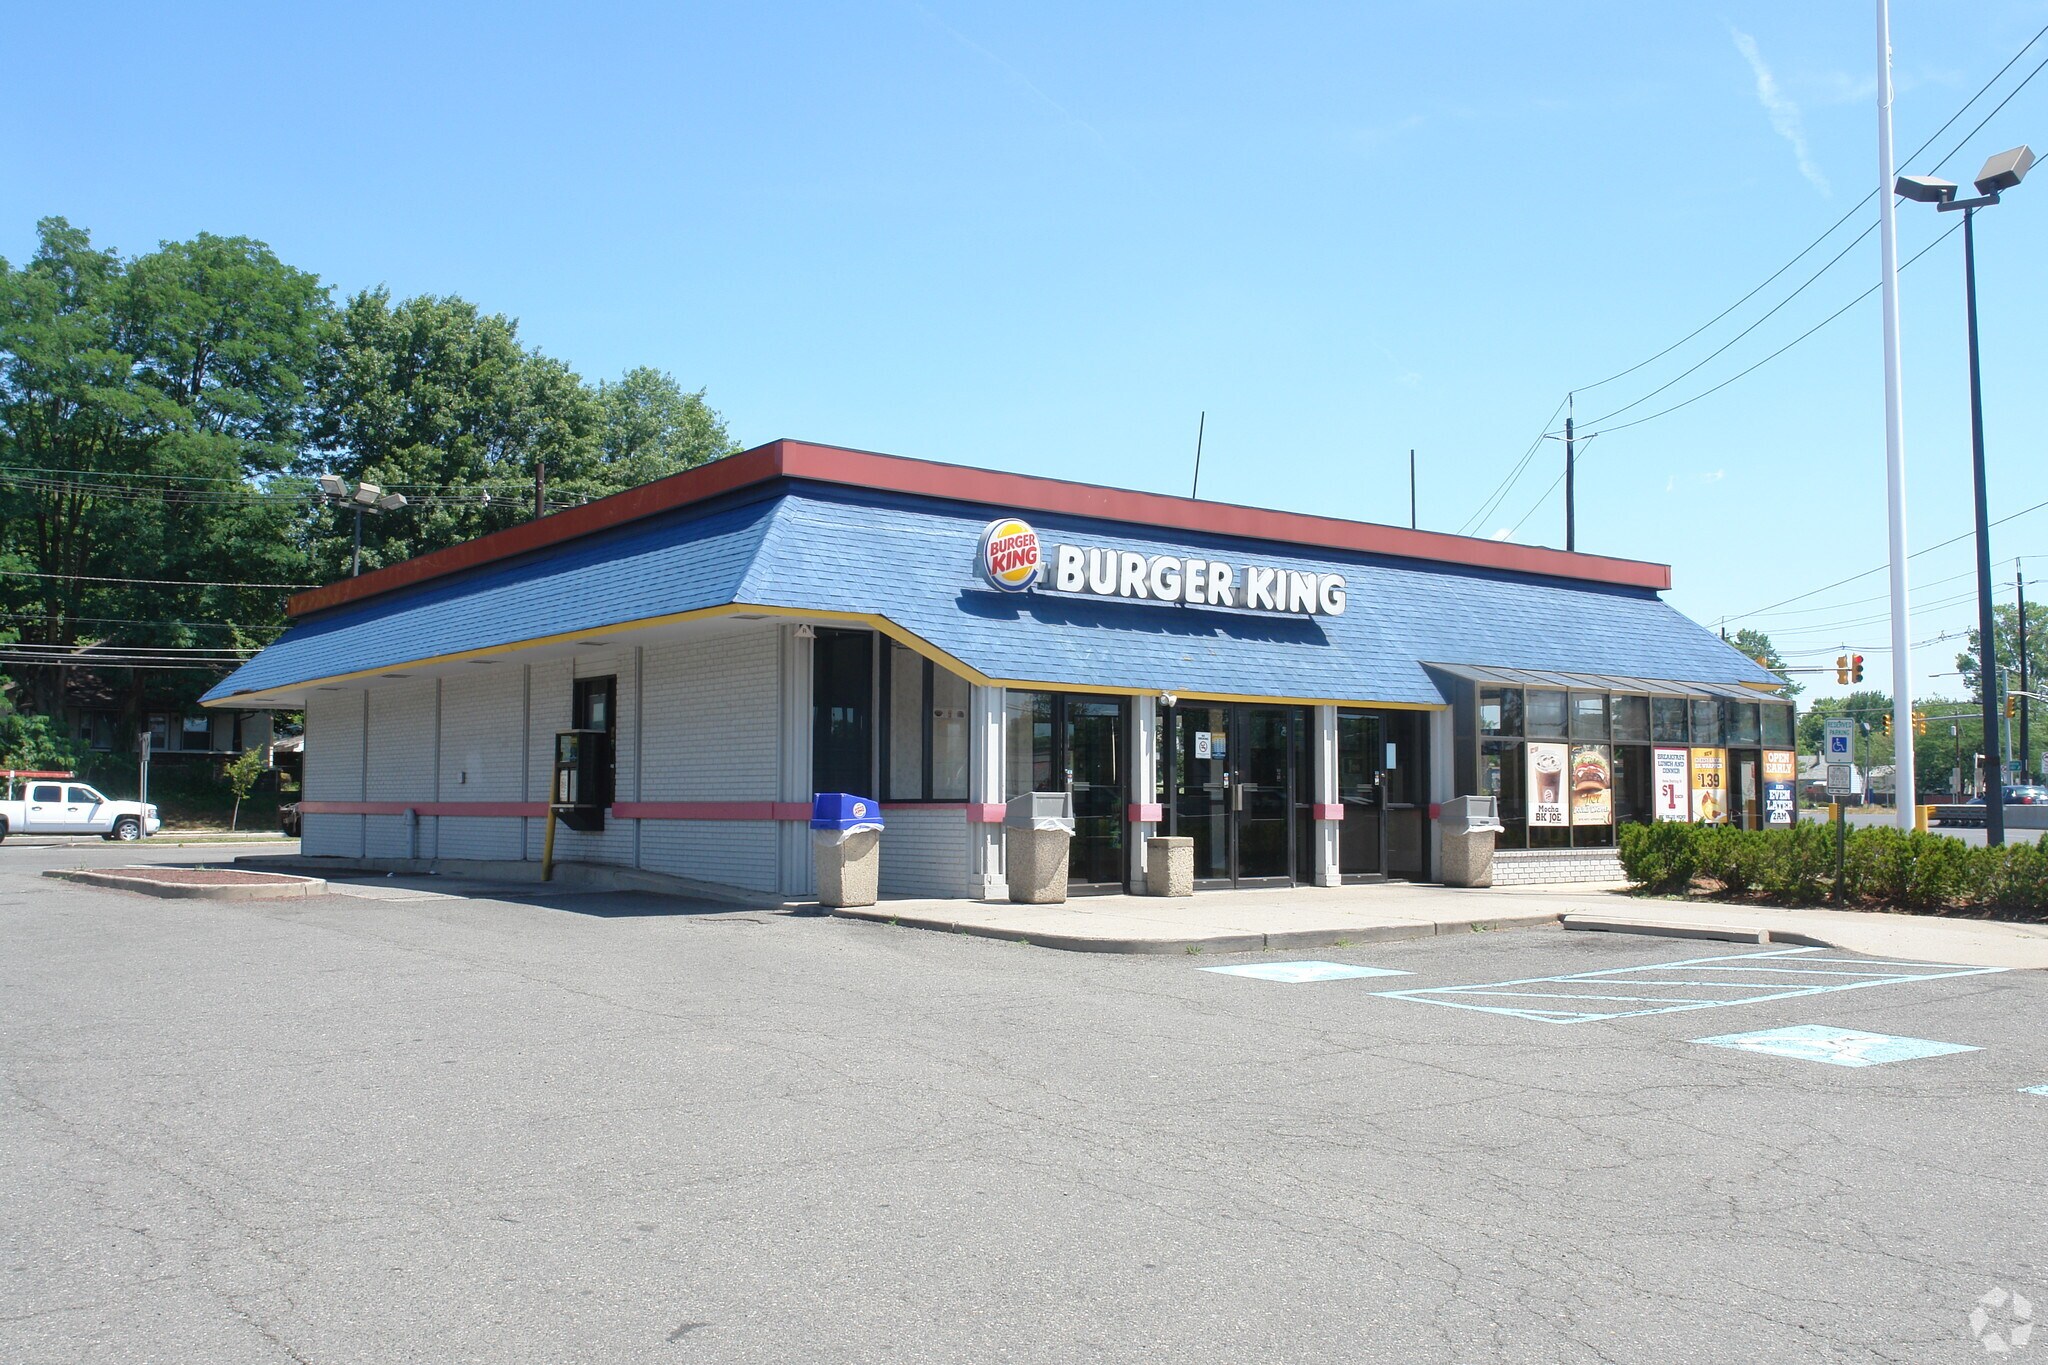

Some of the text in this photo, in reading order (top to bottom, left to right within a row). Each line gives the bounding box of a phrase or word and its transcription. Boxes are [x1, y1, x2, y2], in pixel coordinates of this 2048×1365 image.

[990, 534, 1036, 556] BURGER
[991, 546, 1037, 576] KING
[1055, 544, 1347, 616] BURGER KING
[1767, 752, 1790, 763] OPEN
[1766, 763, 1792, 774] EARLY
[1697, 773, 1720, 787] $1.39
[1662, 784, 1676, 809] $1
[1769, 790, 1791, 800] EVEN
[1538, 805, 1559, 813] Mocha
[1766, 800, 1794, 811] LATER
[1535, 813, 1562, 823] BK JOE
[1772, 812, 1787, 820] 2AM
